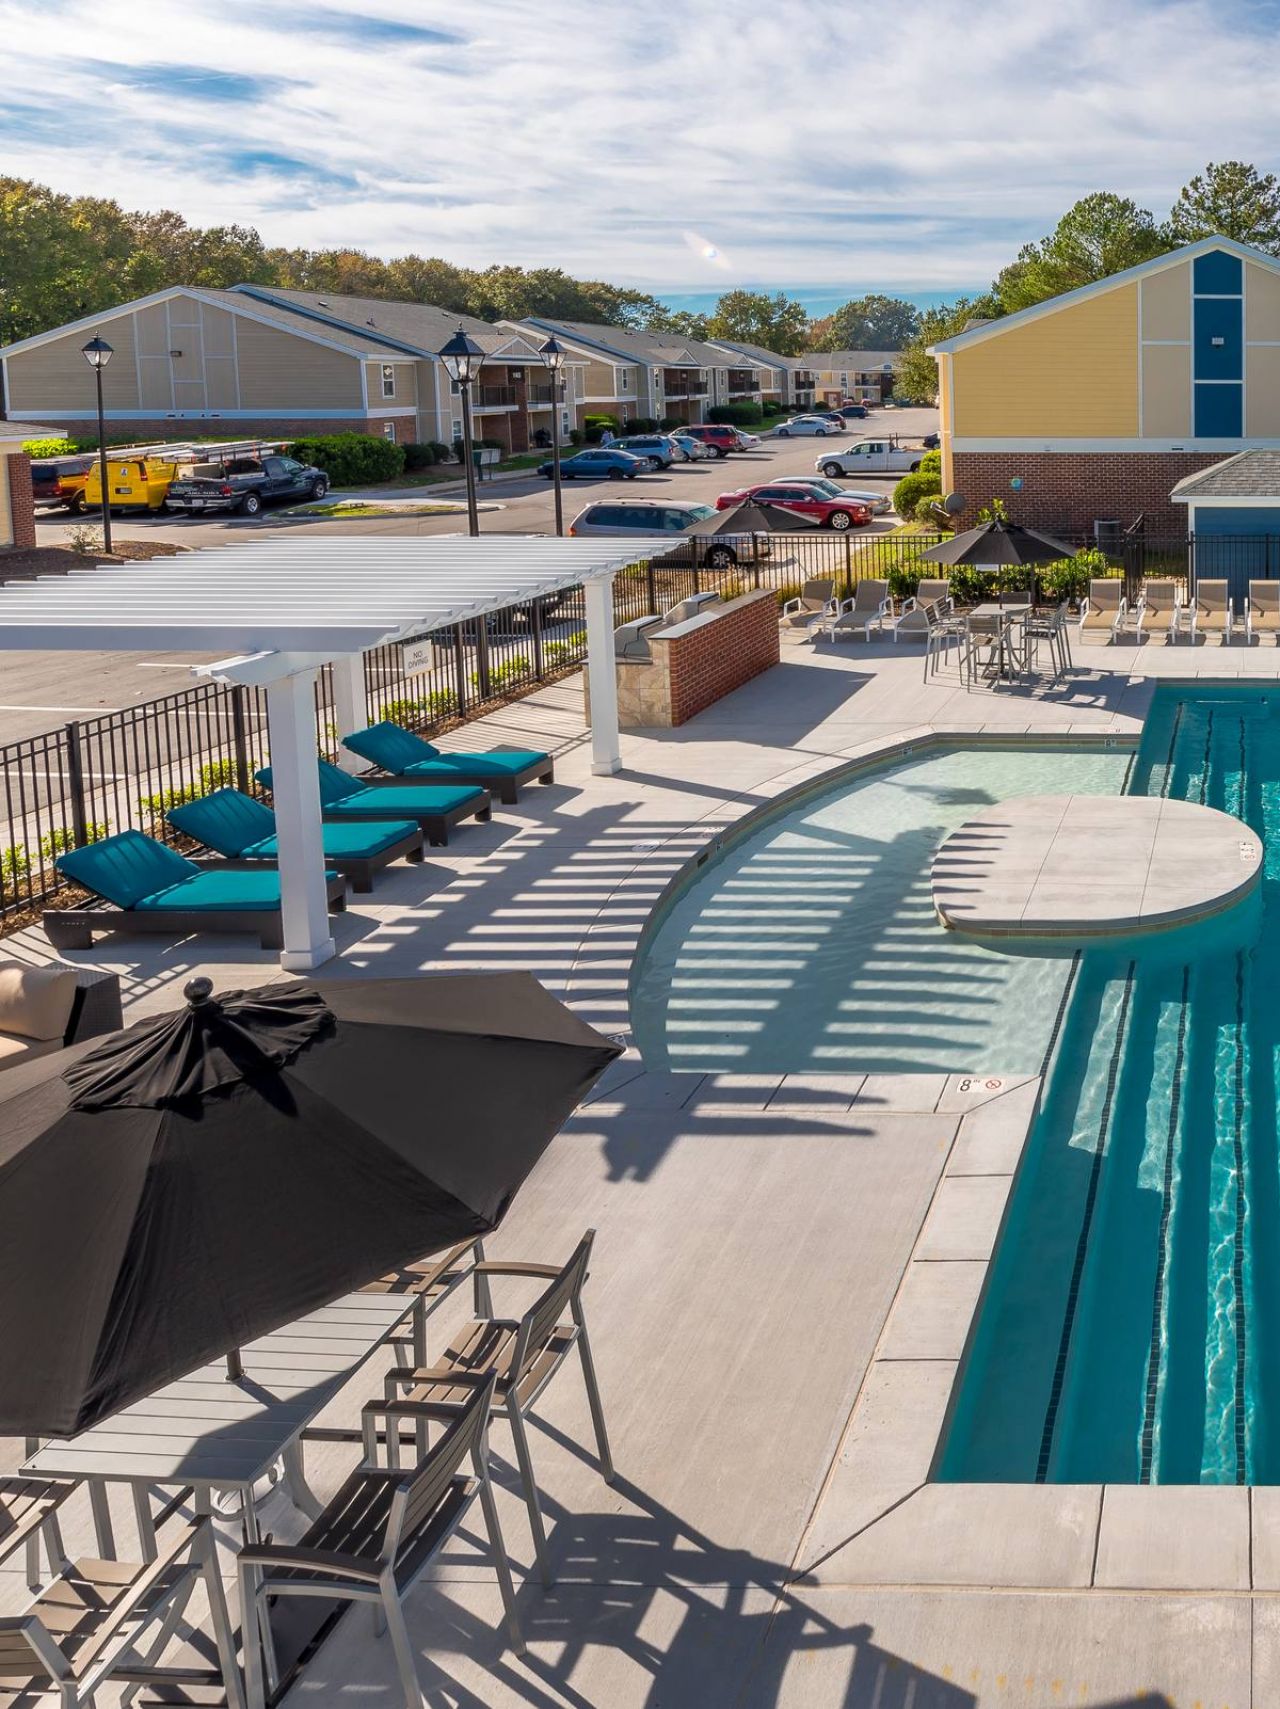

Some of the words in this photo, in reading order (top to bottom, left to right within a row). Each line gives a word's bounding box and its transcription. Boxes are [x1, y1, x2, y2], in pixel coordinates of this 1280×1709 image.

[413, 650, 423, 659] NO
[408, 655, 429, 669] DIVING
[960, 1079, 971, 1092] 8
